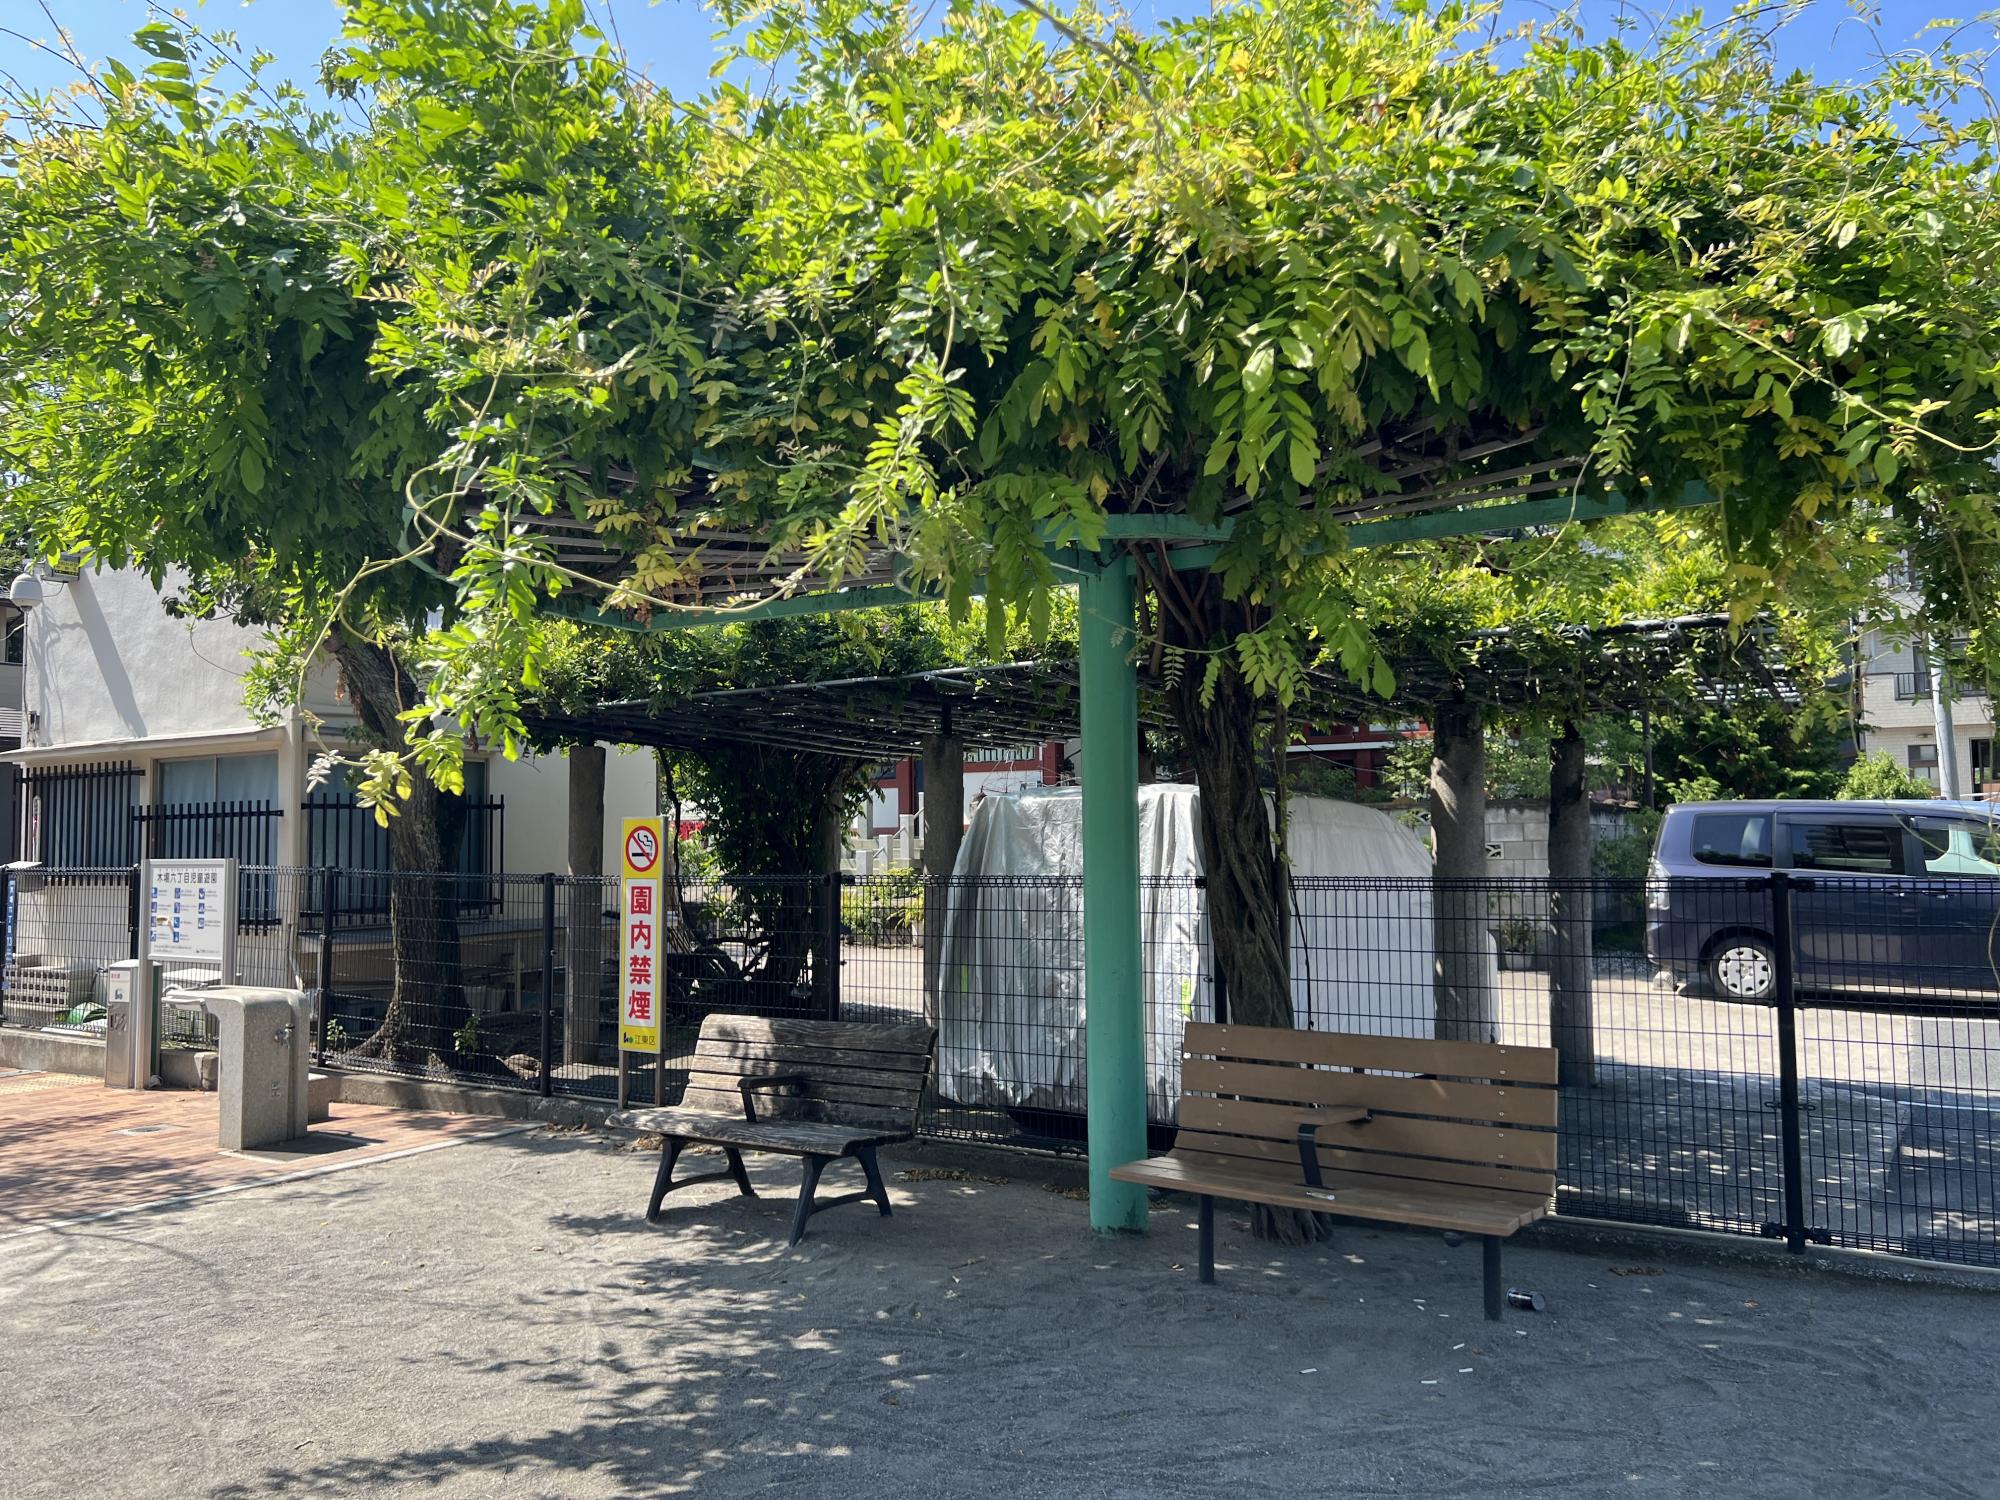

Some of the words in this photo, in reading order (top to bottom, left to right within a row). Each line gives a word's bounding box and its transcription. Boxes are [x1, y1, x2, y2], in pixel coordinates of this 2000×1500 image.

[157, 872, 218, 884] 木場六丁目児童遊園
[628, 885, 653, 1020] 園内禁煙
[634, 1035, 656, 1046] 江東区
